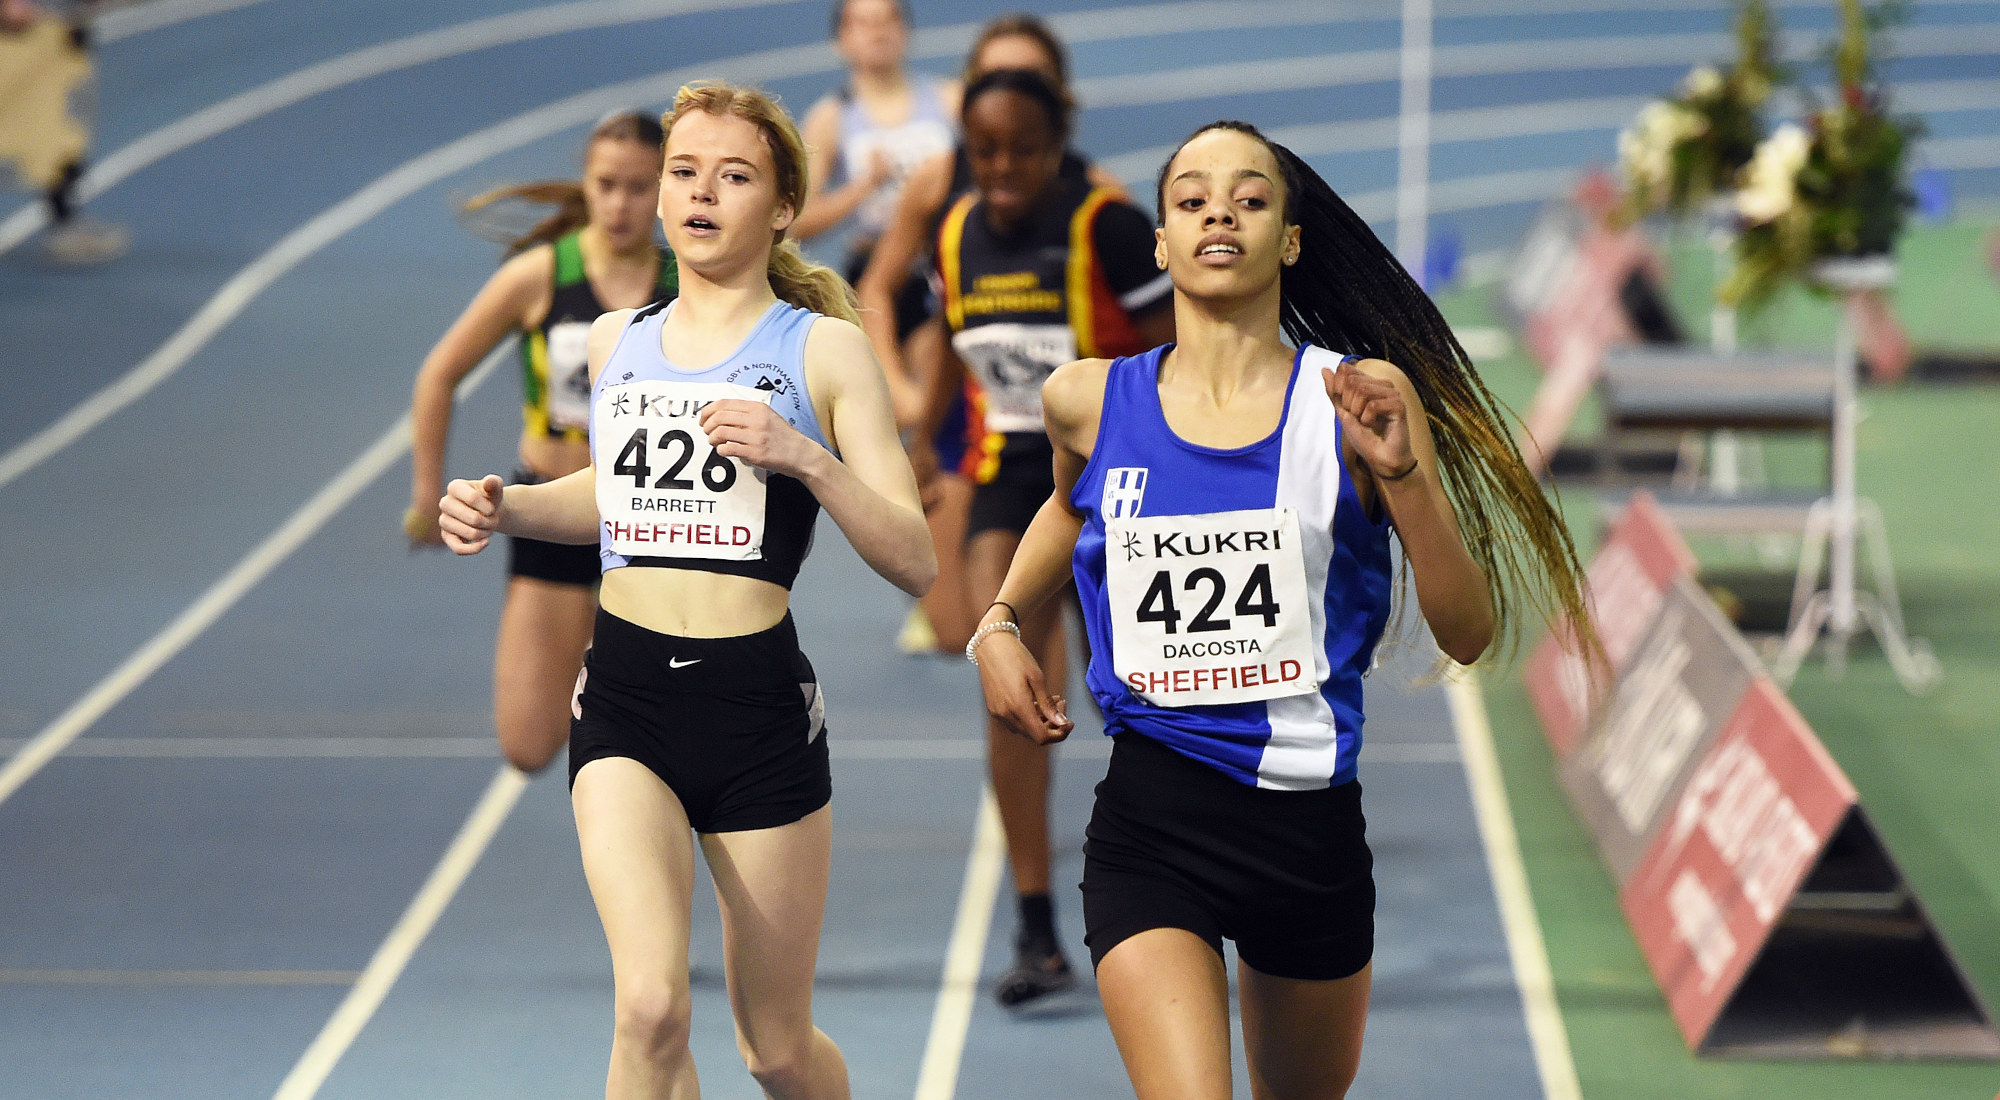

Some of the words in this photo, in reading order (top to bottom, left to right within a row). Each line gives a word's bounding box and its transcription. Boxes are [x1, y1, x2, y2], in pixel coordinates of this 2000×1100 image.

[726, 368, 742, 383] GBY
[752, 362, 801, 411] NORTHAMPTON
[639, 394, 714, 419] KUK
[613, 428, 737, 493] 426
[631, 497, 717, 514] BARRETT
[1154, 530, 1282, 558] KUKRI
[1136, 563, 1280, 635] 424
[1163, 639, 1262, 659] DACOSTA
[1127, 659, 1302, 693] SHEFFIELD
